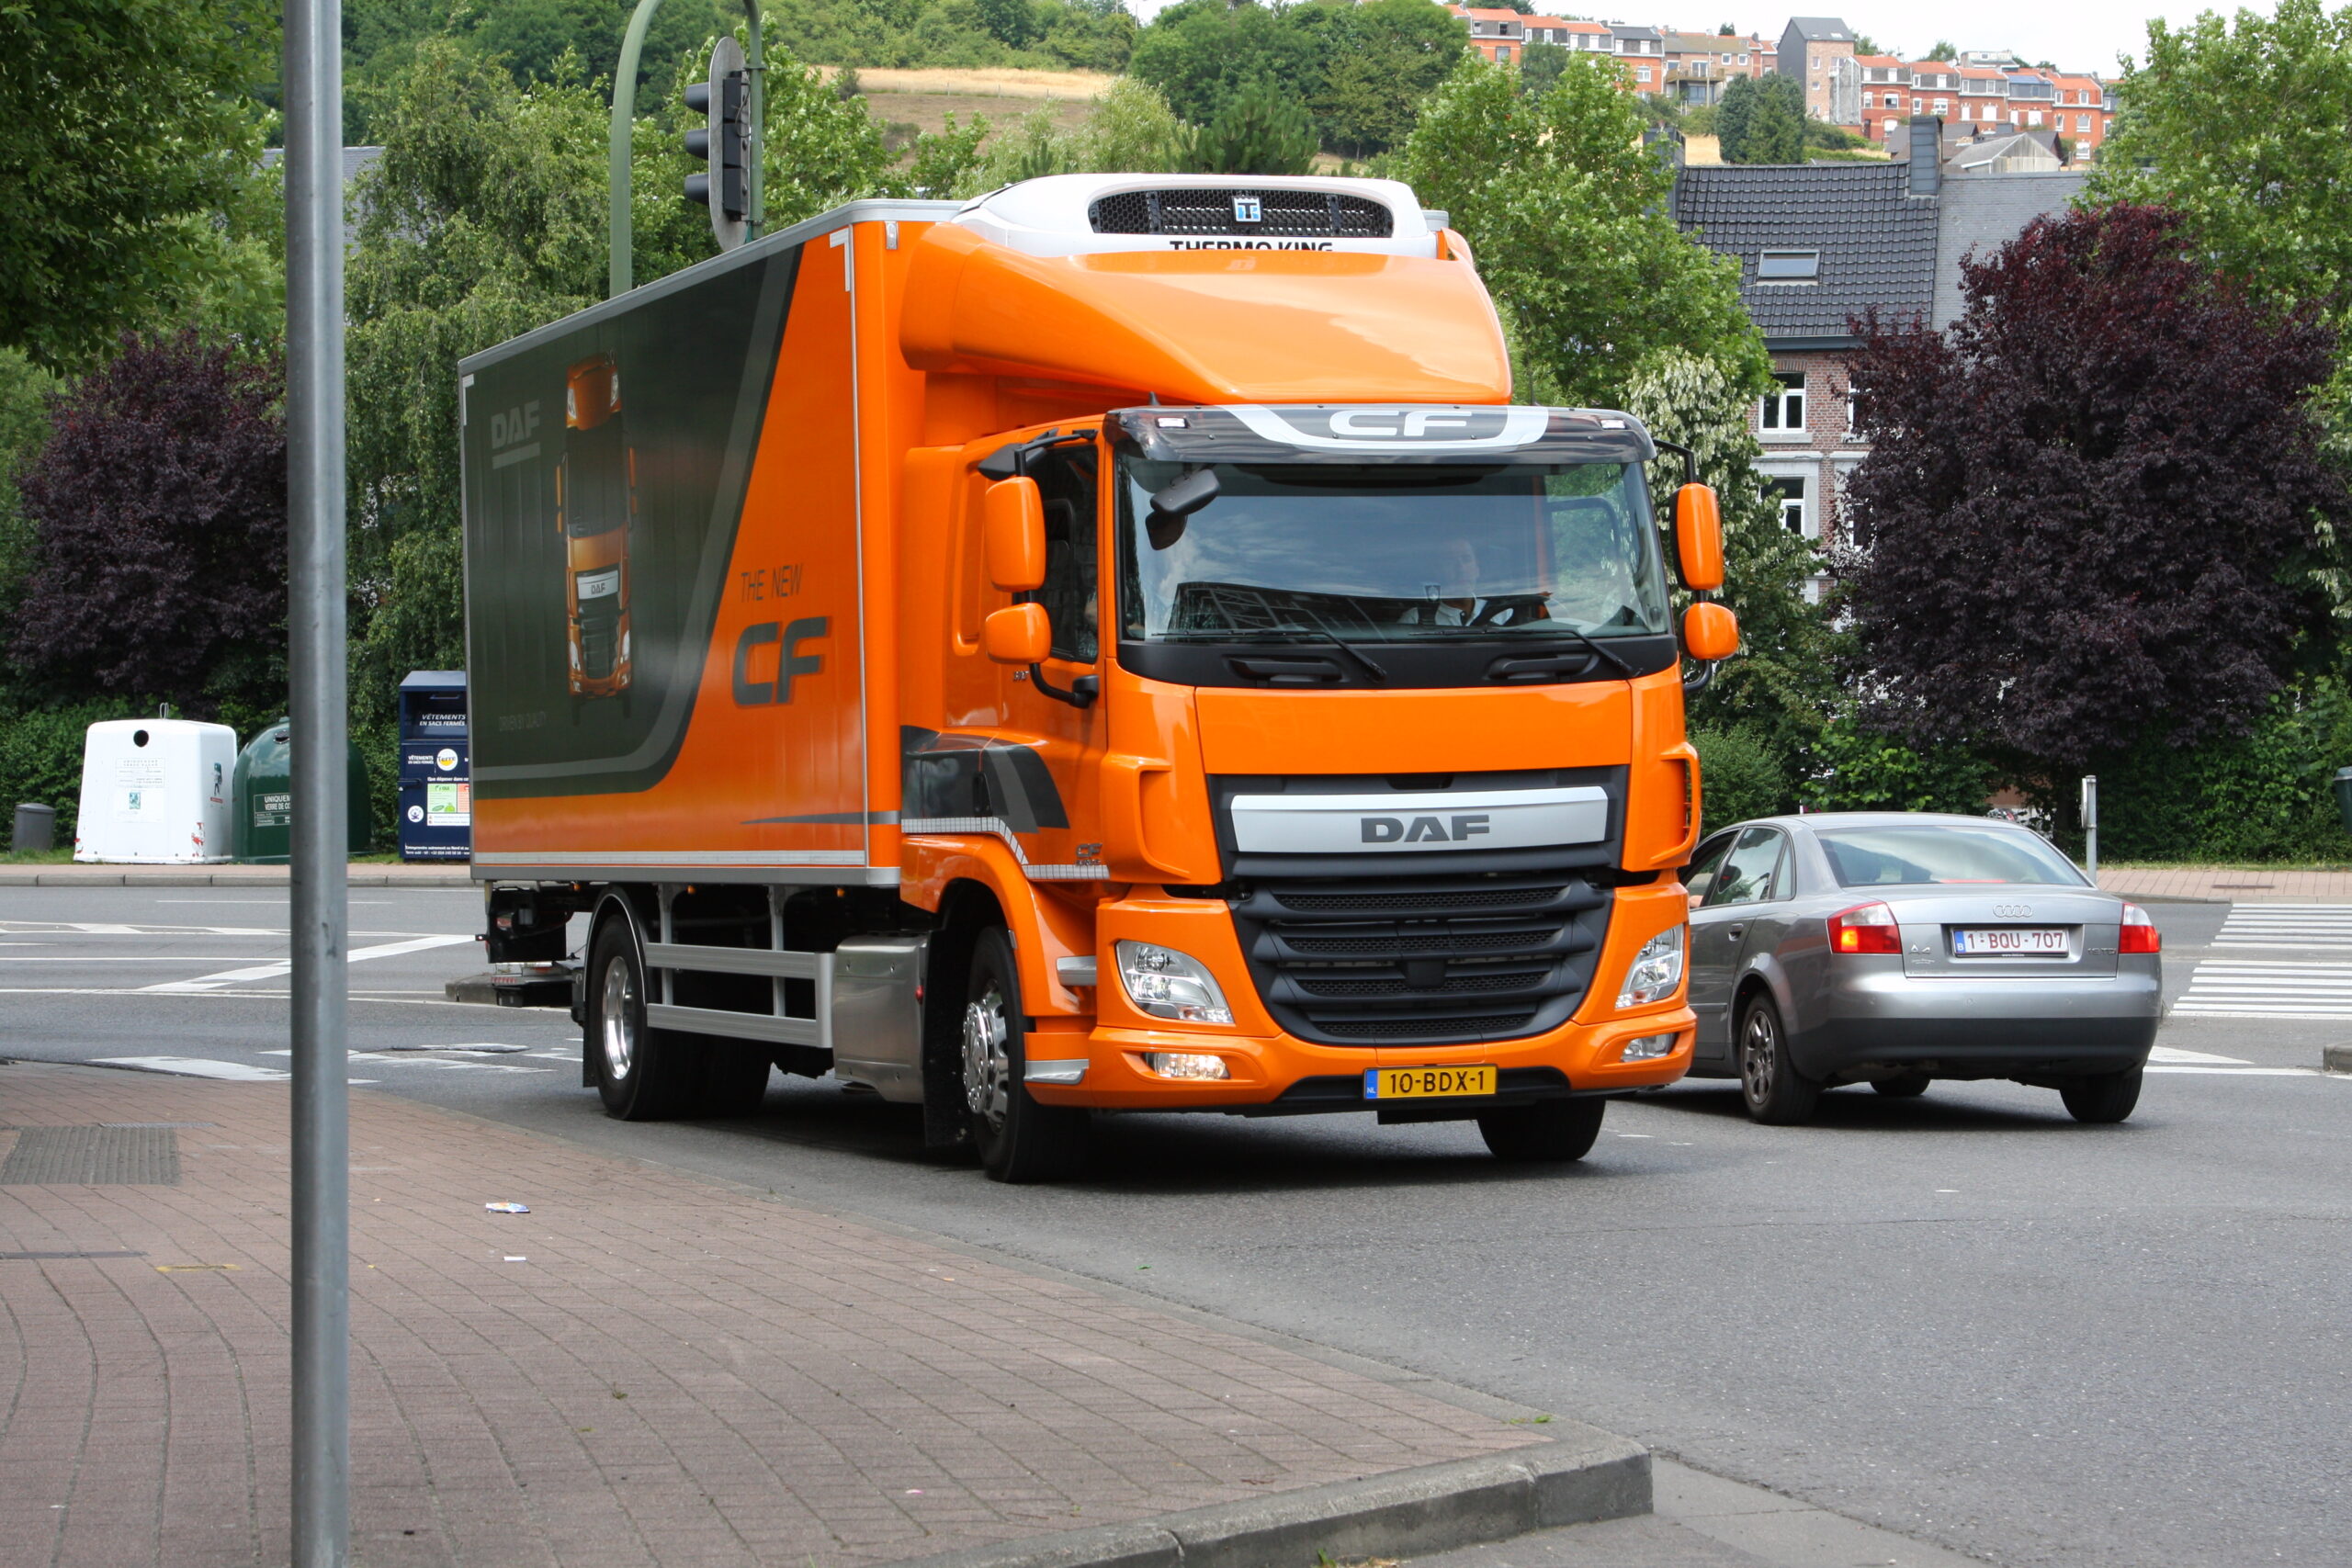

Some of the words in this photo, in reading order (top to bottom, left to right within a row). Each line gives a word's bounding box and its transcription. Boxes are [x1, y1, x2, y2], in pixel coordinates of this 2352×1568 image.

[491, 399, 540, 450] DAF
[1329, 410, 1472, 436] CF
[591, 582, 605, 595] DAF
[741, 570, 765, 603] THE
[772, 563, 803, 599] NEW
[732, 615, 831, 708] CF
[1361, 815, 1489, 843] DAF
[1076, 843, 1102, 857] CF
[1957, 942, 1964, 952] B
[1366, 1087, 1376, 1095] NL
[1390, 1071, 1484, 1094] 10-BDX-1
